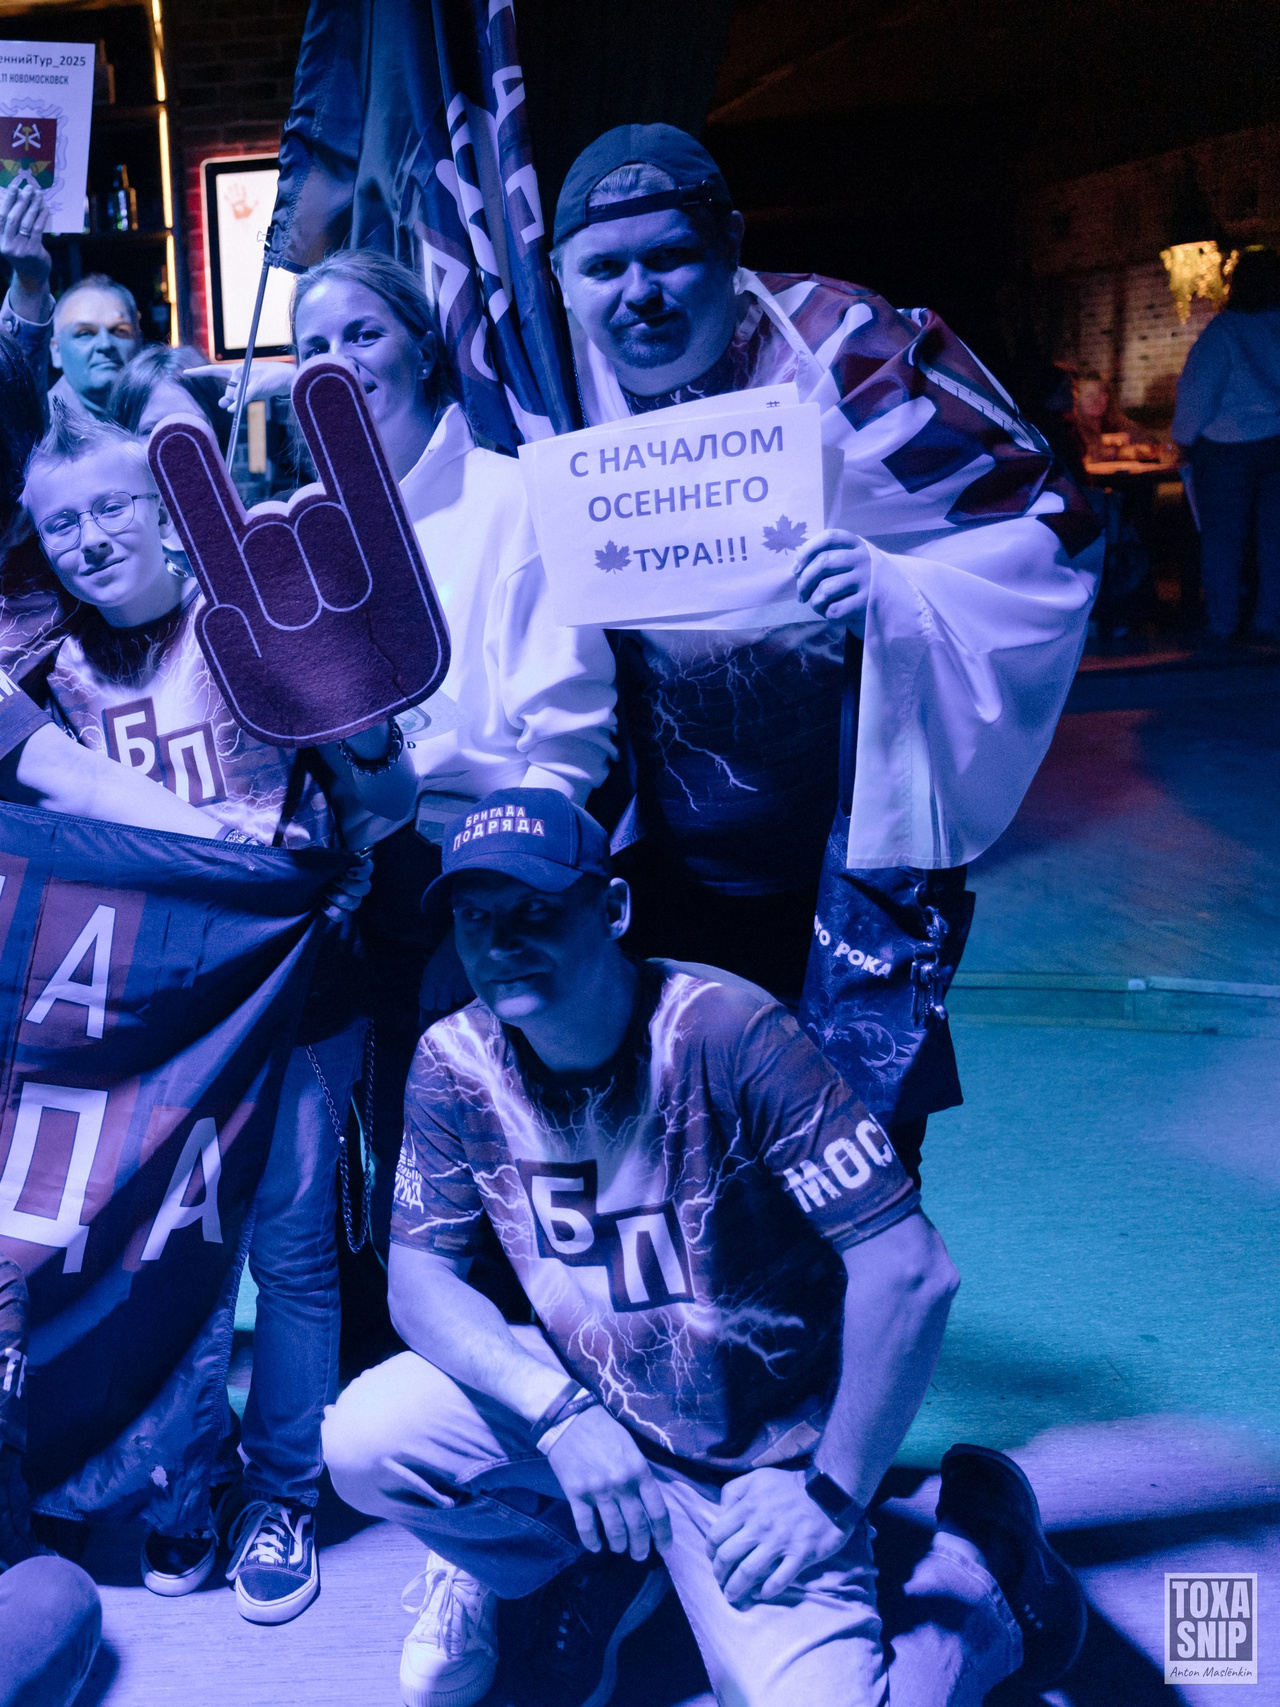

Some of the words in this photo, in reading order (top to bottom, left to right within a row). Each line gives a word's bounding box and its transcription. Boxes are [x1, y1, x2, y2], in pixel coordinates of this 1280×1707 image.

[9, 74, 69, 85] НОВОМОСКОВСК
[570, 451, 590, 478] С
[599, 425, 784, 475] НАЧАЛОМ
[588, 476, 769, 523] ОСЕННЕГО
[632, 535, 749, 573] ТУРА!!!
[113, 711, 217, 801] БП
[464, 805, 526, 827] БРИГАДА
[452, 819, 545, 853] ПОДРЯДА
[833, 941, 892, 977] РОКА
[531, 1175, 687, 1304] БП
